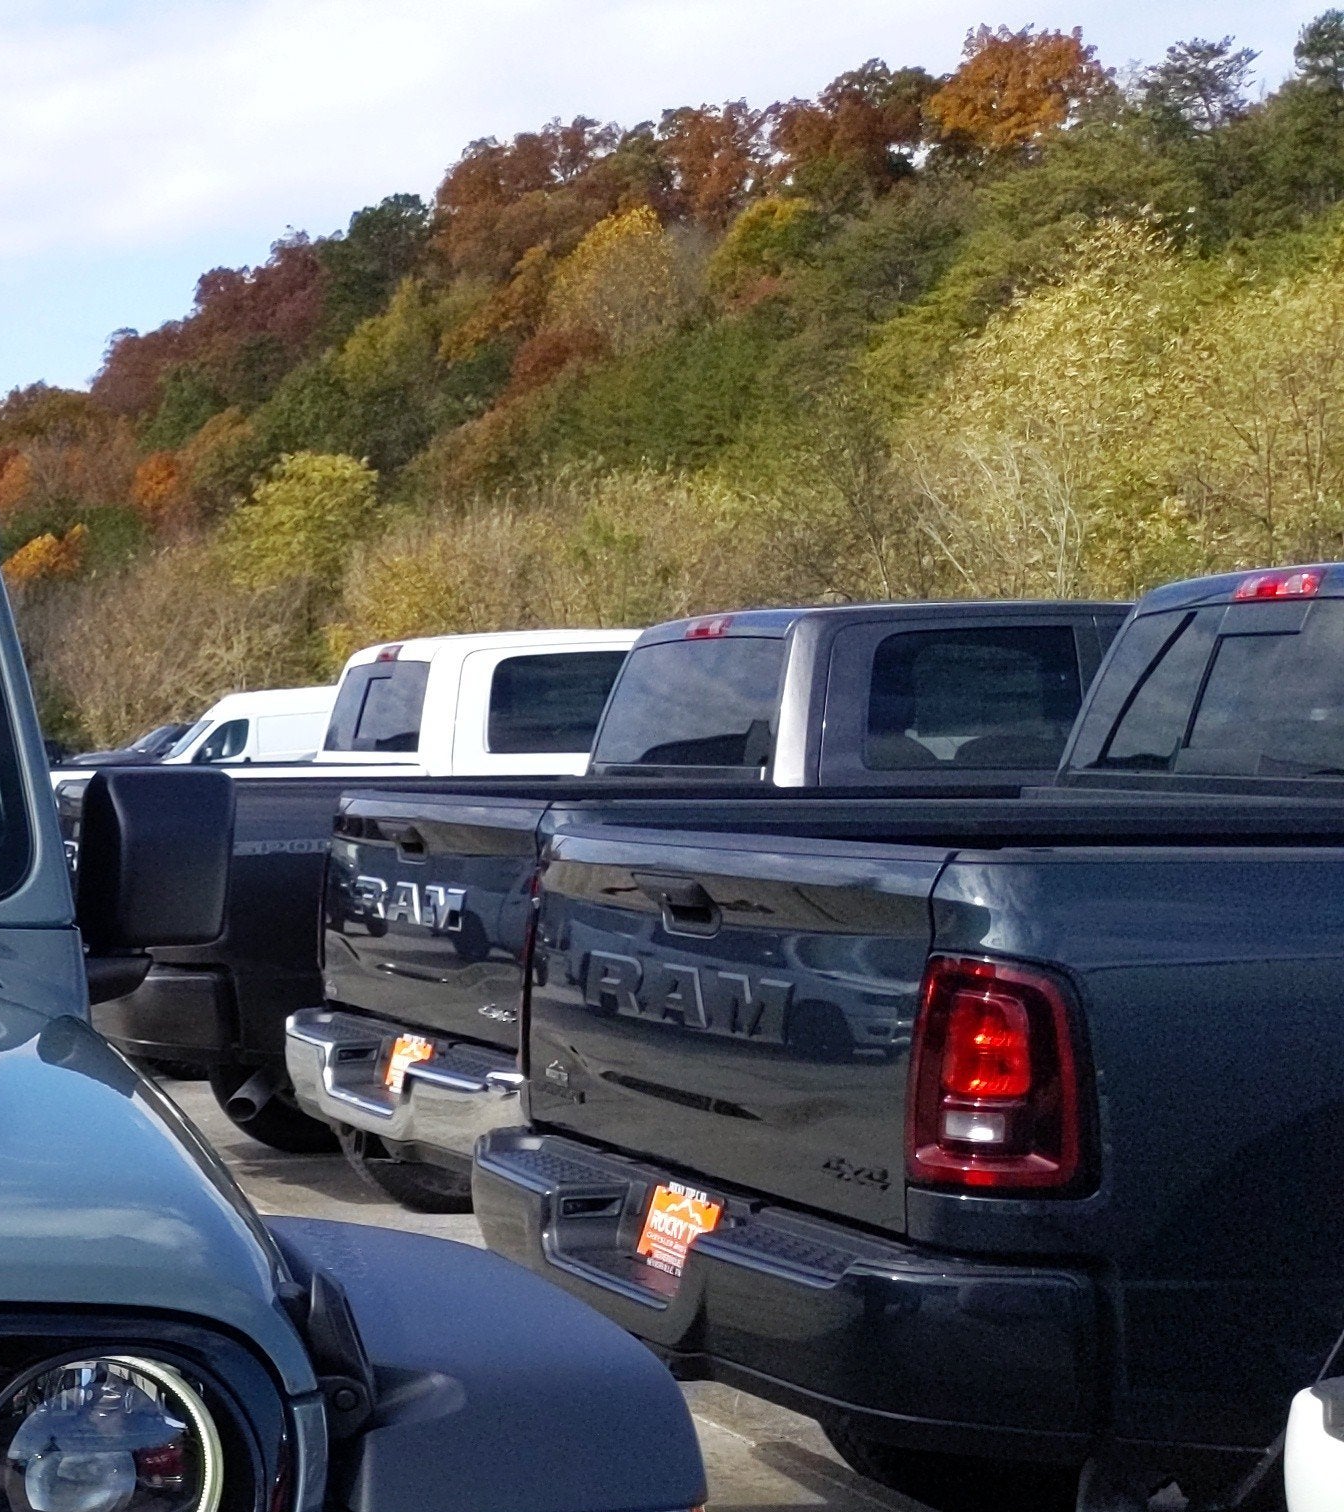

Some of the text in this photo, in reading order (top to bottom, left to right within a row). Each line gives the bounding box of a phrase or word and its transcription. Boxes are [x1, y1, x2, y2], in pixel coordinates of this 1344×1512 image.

[354, 875, 467, 932] RAM
[585, 950, 795, 1045] RAM
[650, 1209, 685, 1240] ROCKY
